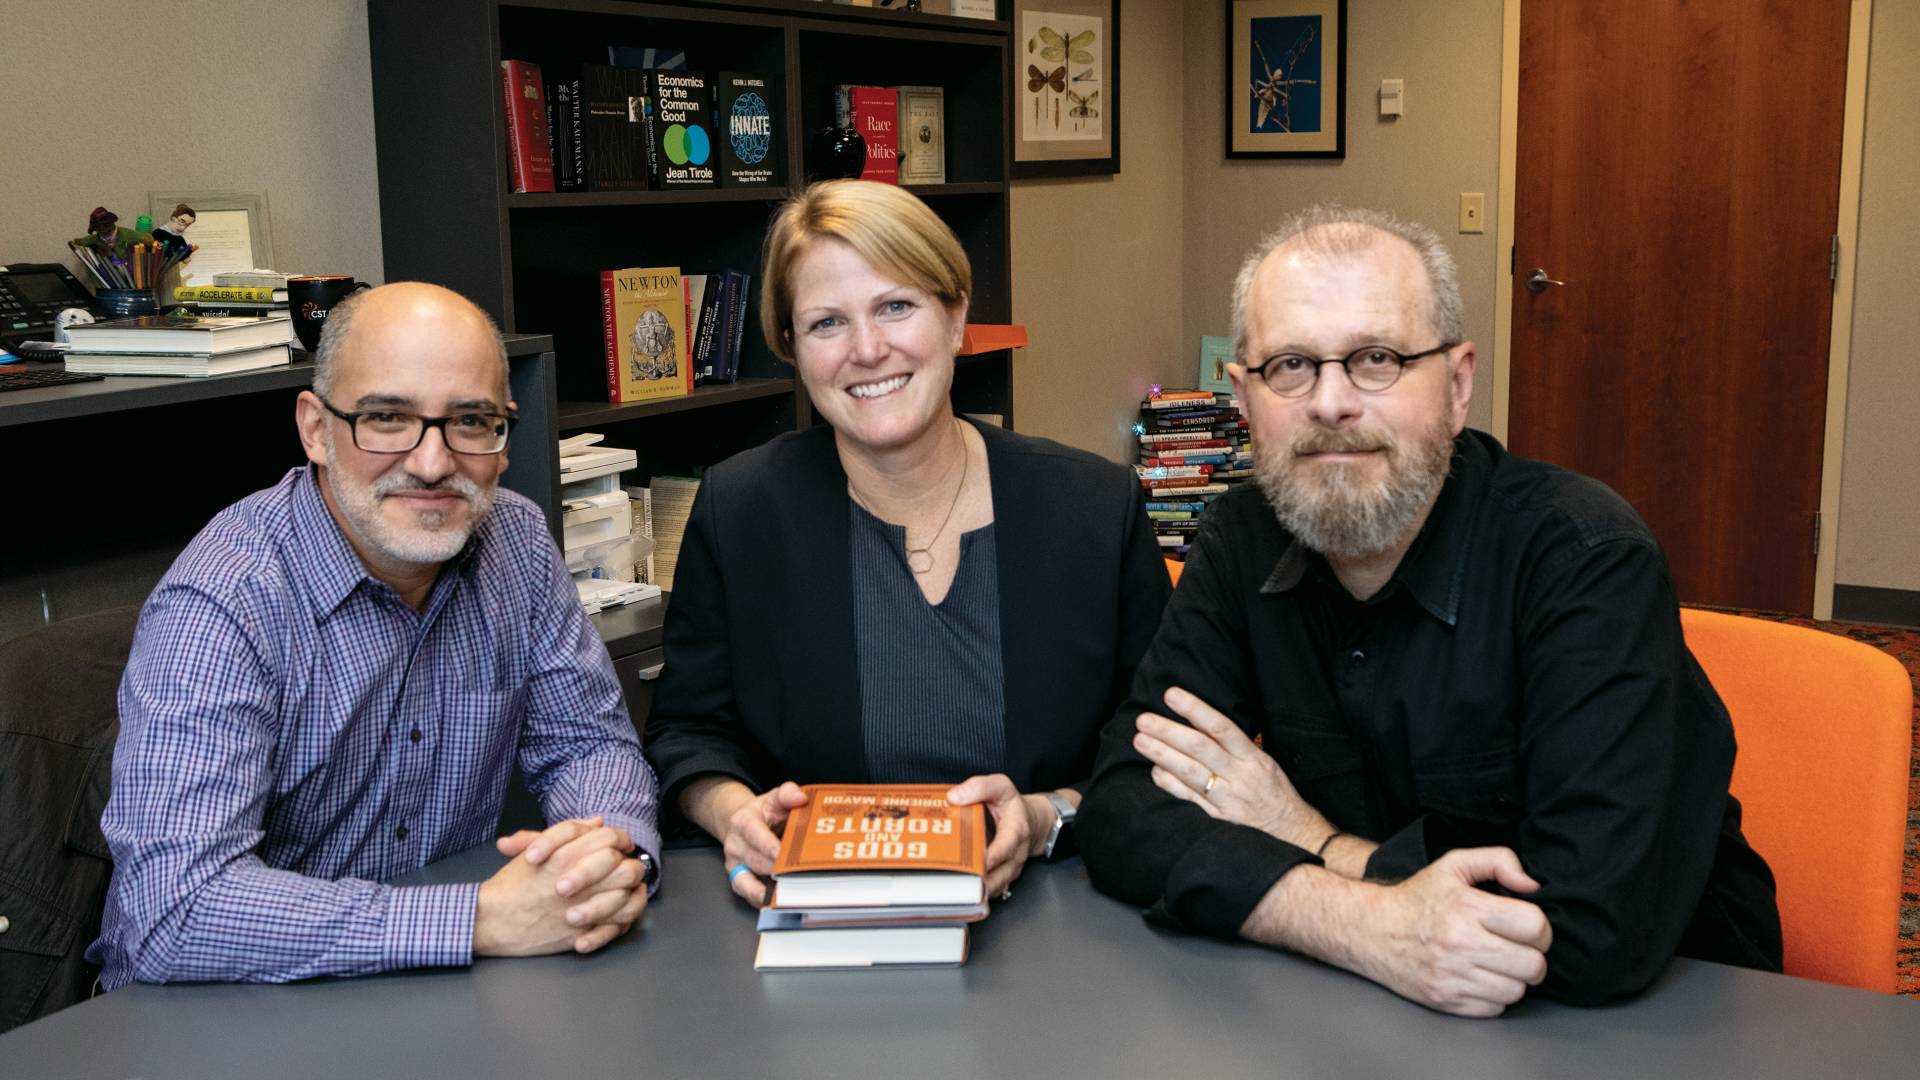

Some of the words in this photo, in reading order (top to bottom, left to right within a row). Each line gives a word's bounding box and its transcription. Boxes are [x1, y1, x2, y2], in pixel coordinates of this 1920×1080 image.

[658, 74, 704, 88] Economics
[572, 80, 580, 118] WALTER
[659, 86, 671, 98] for
[673, 87, 687, 99] the
[660, 98, 699, 111] Common
[661, 110, 686, 122] Good
[730, 115, 770, 136] INNATE
[867, 115, 891, 131] Race
[573, 120, 583, 174] KAUFMANN
[666, 167, 688, 179] Jean
[689, 167, 713, 179] Tirole
[618, 274, 678, 292] NEWTON
[200, 290, 243, 300] ACCELERATE
[603, 287, 612, 321] NEWTON
[202, 309, 230, 317] suicidal
[607, 340, 616, 385] ALCHEMIST
[1169, 399, 1205, 408] IDLENESS
[1182, 416, 1216, 426] CENSORED
[823, 794, 876, 805] MAYOR
[816, 817, 952, 835] ROBOTS
[864, 832, 901, 842] AND
[833, 841, 929, 860] GODS
